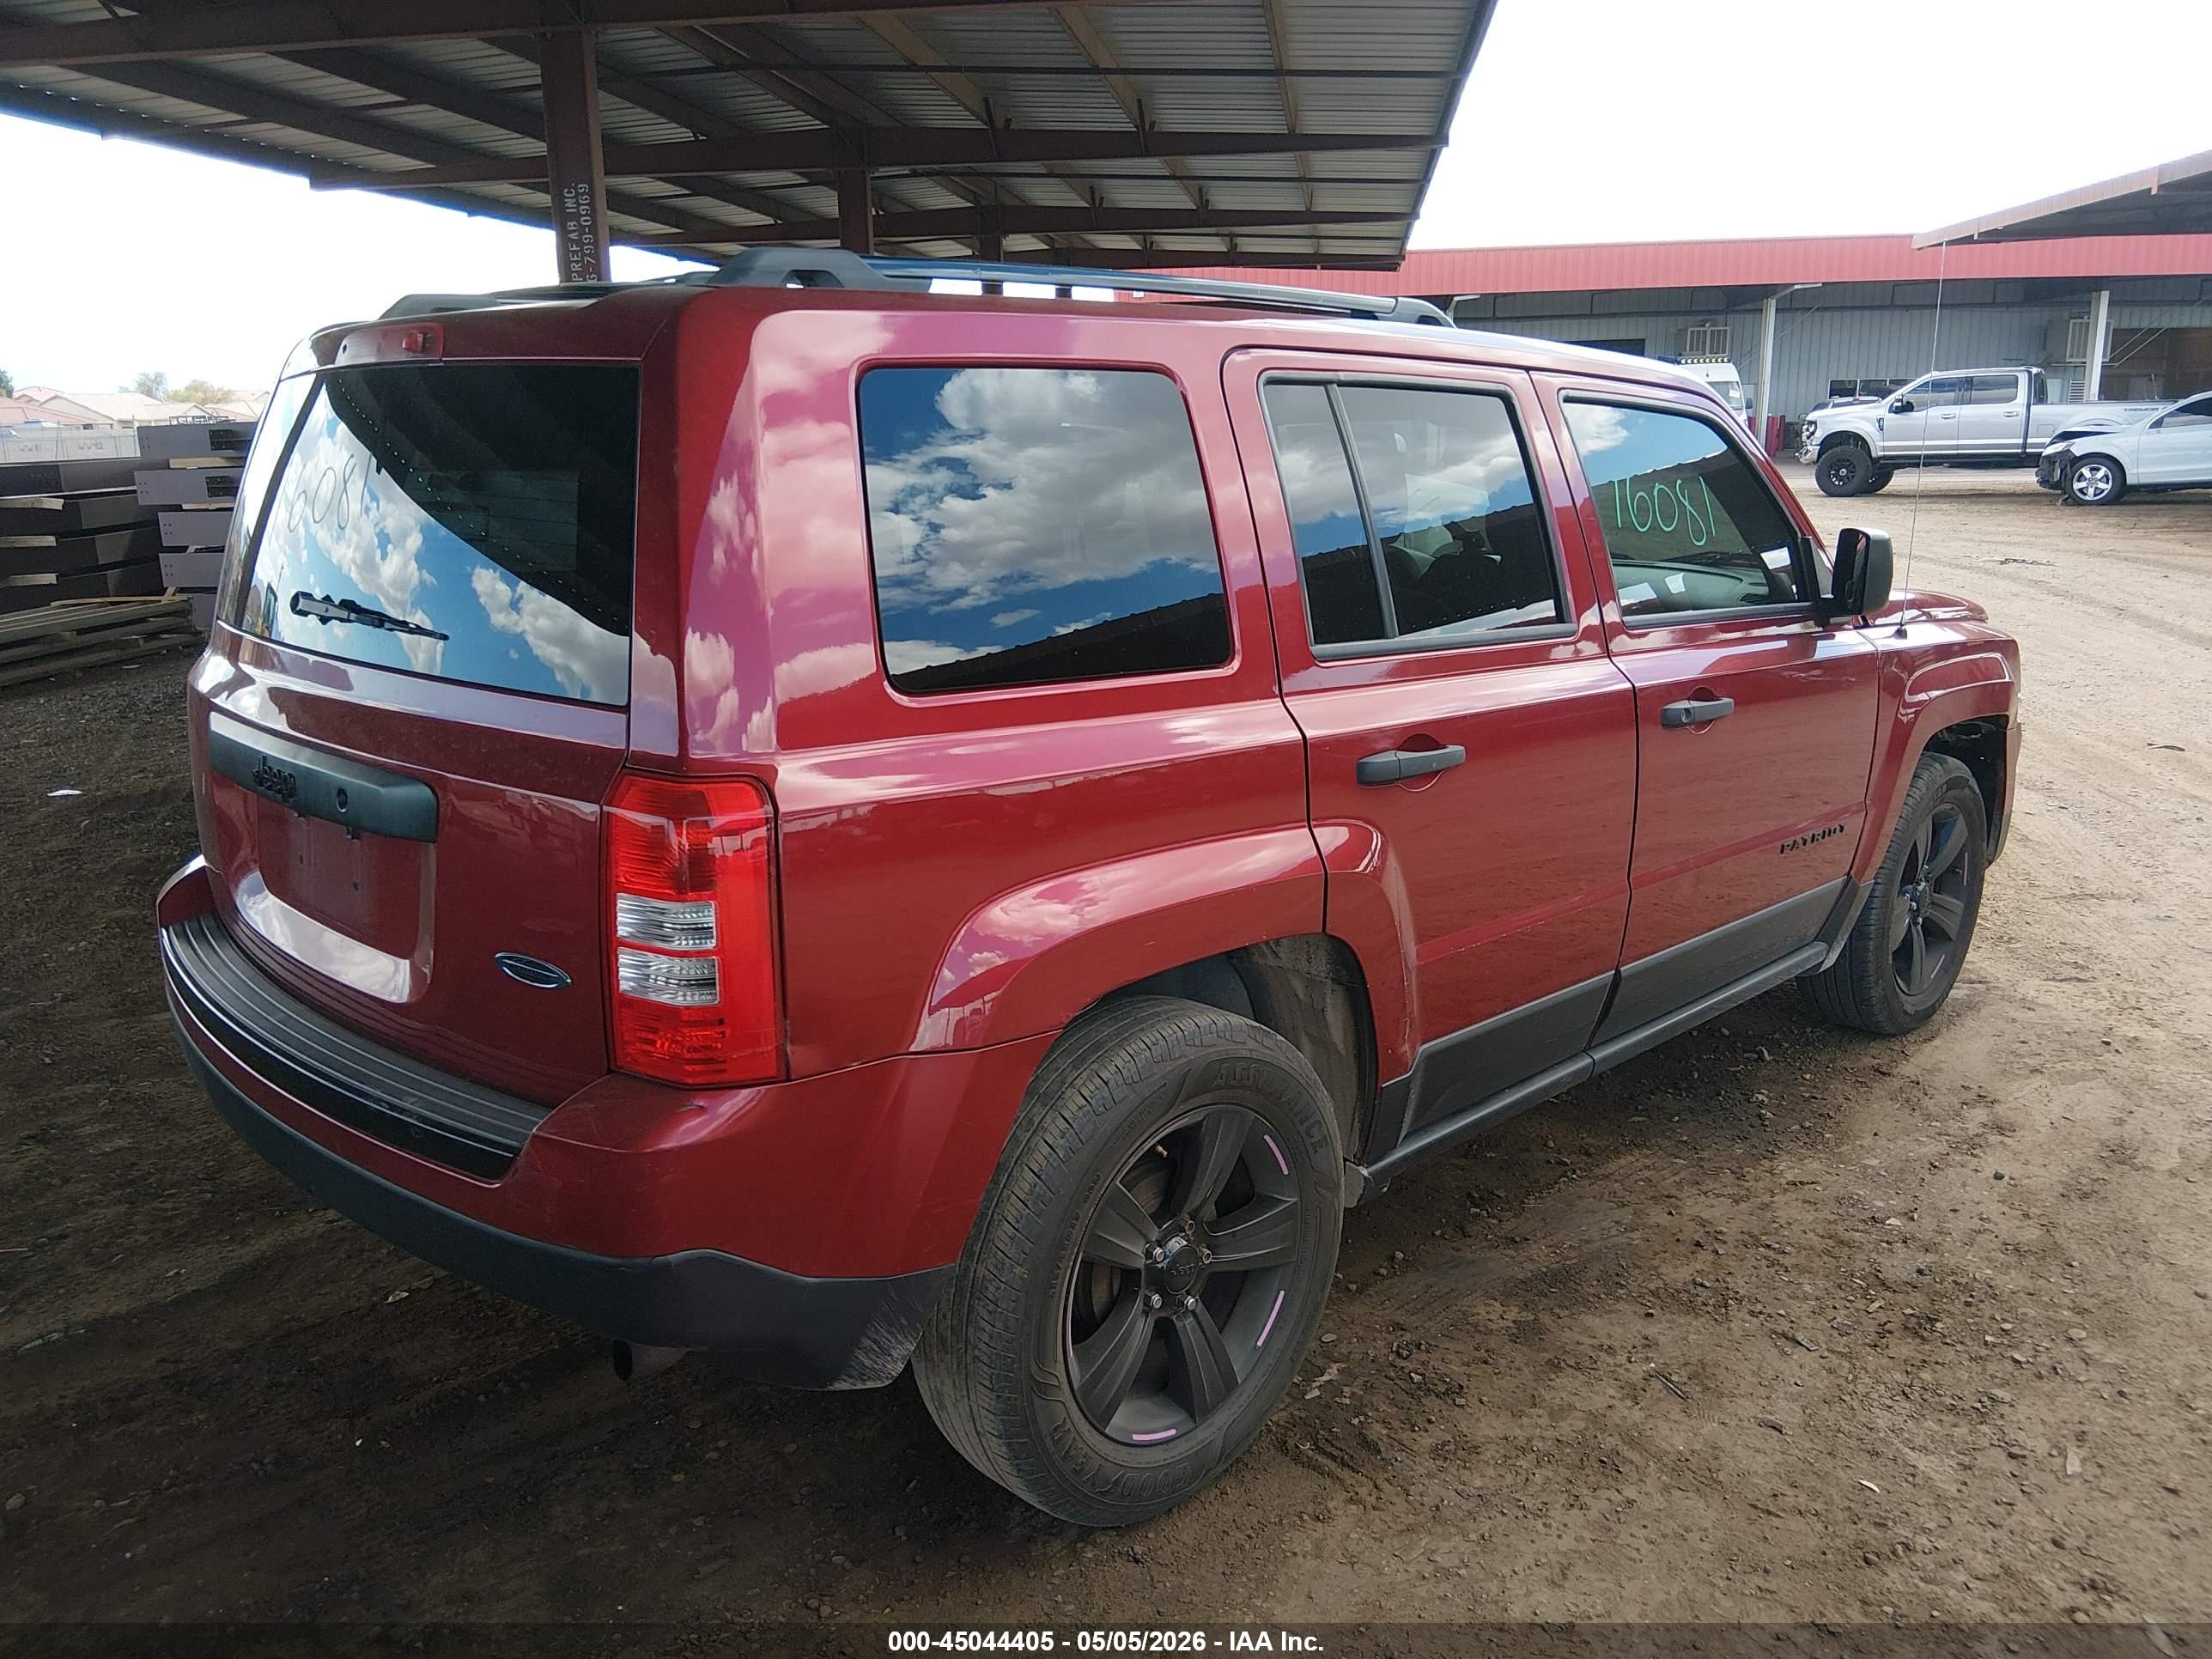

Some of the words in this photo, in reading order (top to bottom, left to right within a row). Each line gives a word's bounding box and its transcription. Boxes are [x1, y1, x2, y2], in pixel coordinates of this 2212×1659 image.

[562, 182, 578, 213] INC.
[566, 221, 584, 282] PREFAB
[1614, 475, 1716, 546] 16081
[252, 755, 297, 802] Jeep
[1779, 824, 1844, 854] PATRIOT
[1212, 1063, 1329, 1155] ASSURANCE
